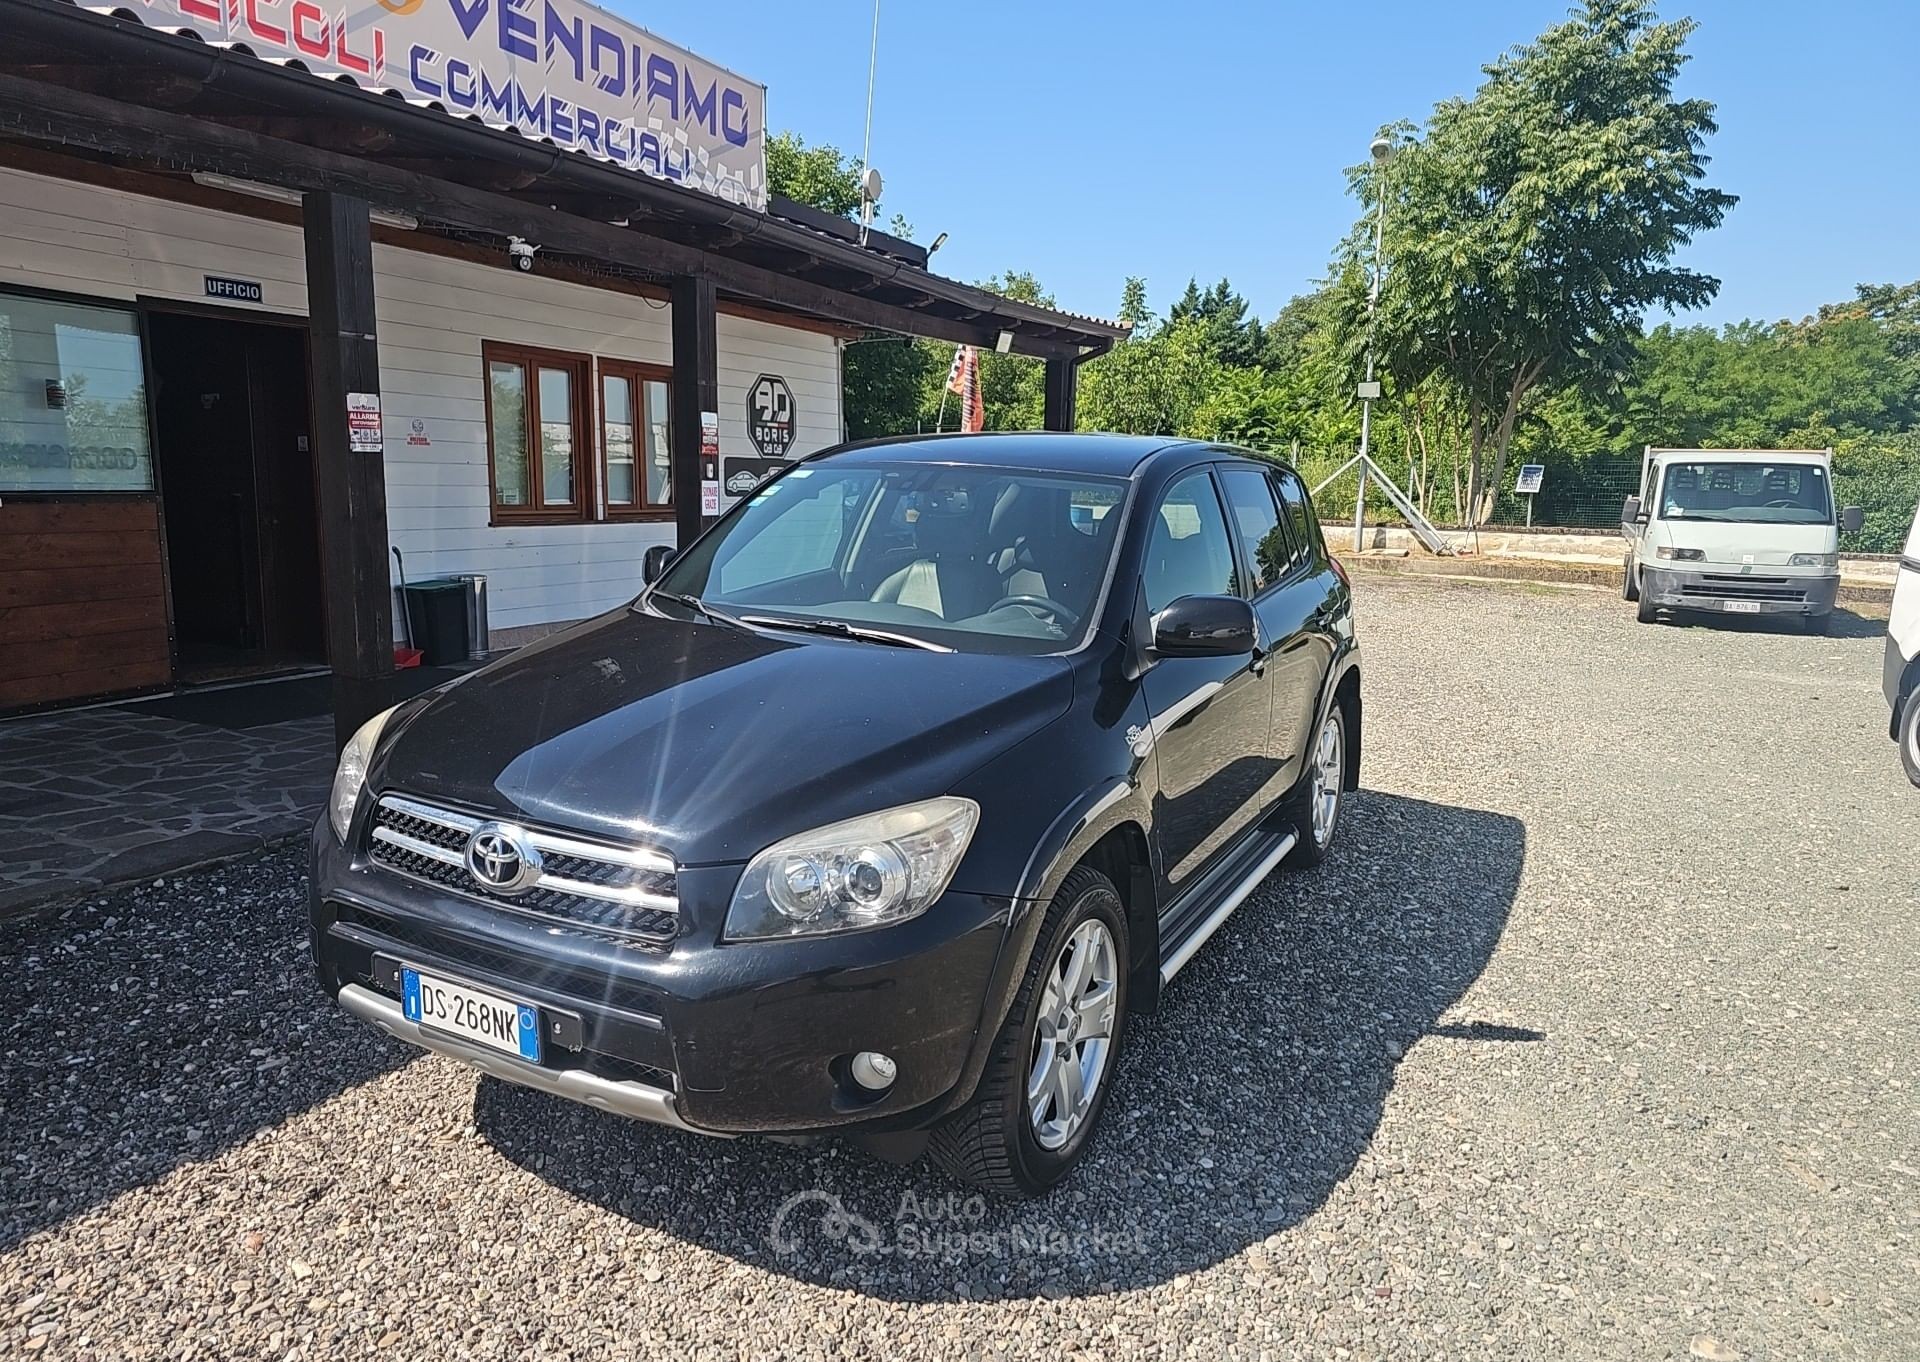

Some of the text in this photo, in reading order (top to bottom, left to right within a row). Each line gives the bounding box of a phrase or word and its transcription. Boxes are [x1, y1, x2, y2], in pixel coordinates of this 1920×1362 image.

[141, 0, 690, 183] ICOLI COMMERCIALI
[207, 280, 260, 299] UFFICIO
[755, 427, 789, 443] BORIS
[422, 984, 447, 1019] DS
[453, 995, 518, 1046] 268NK
